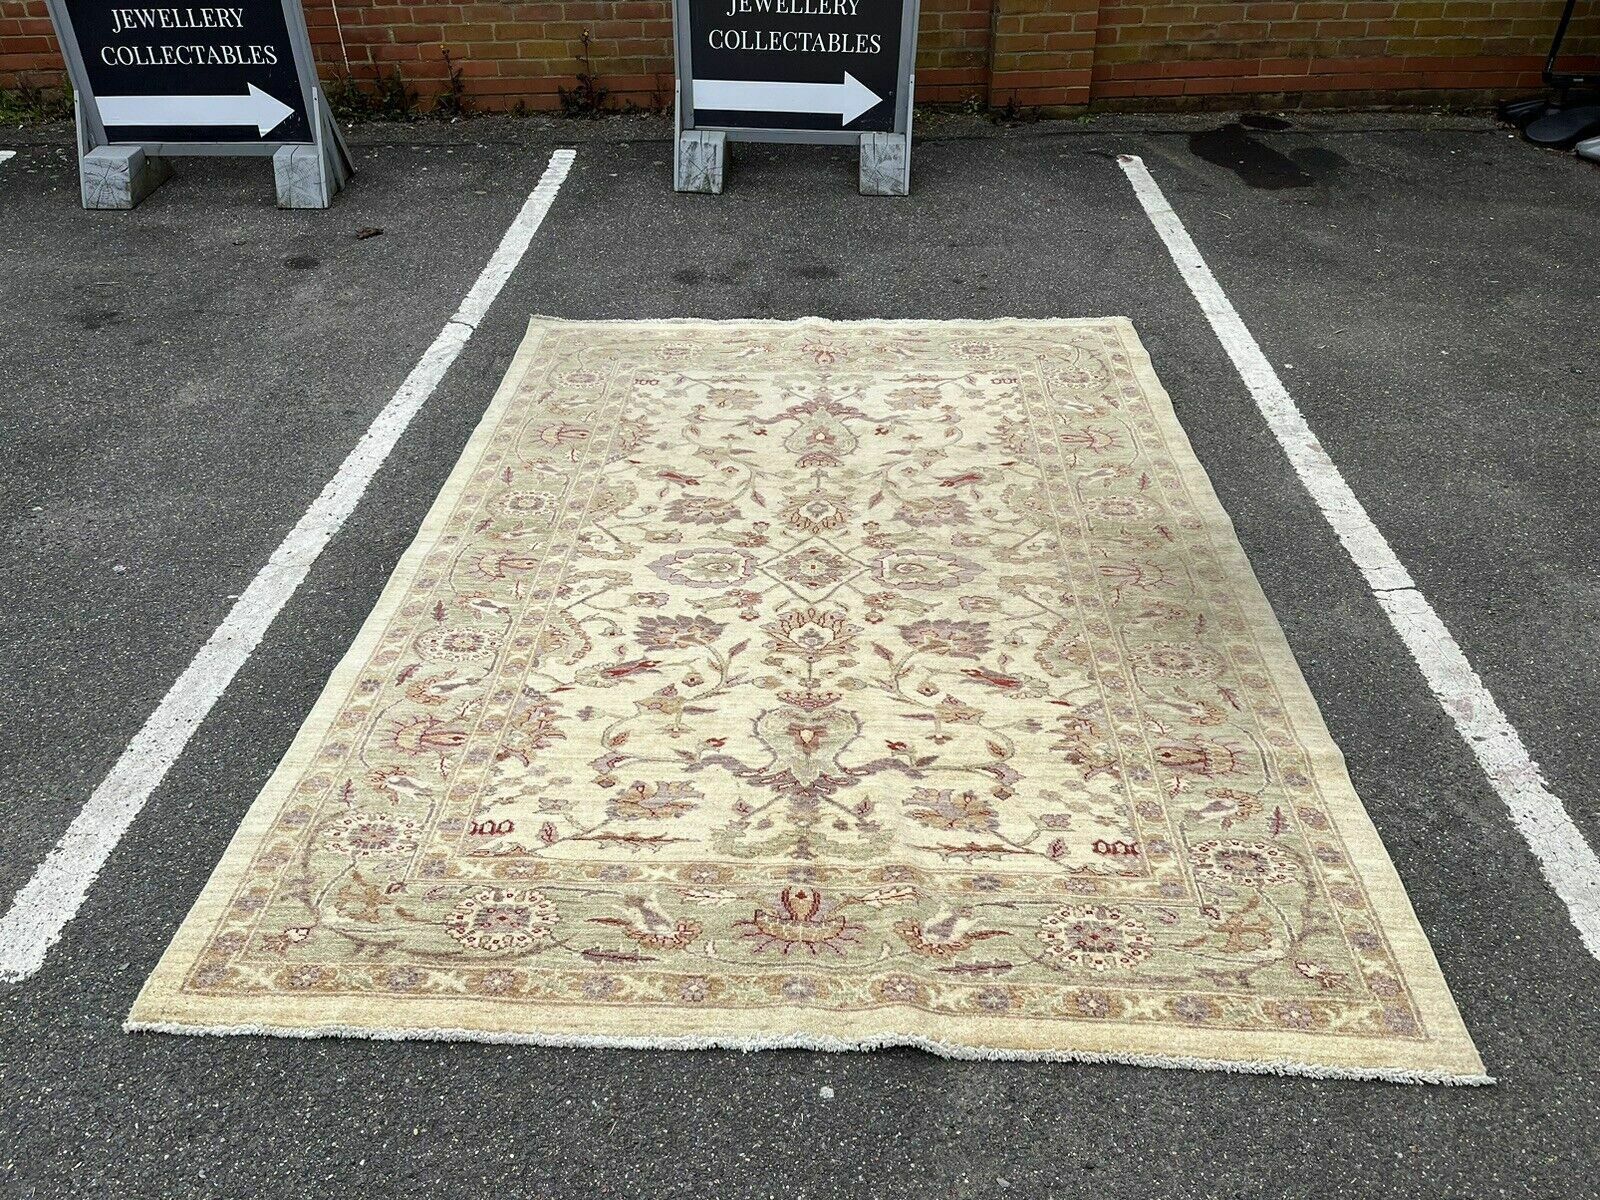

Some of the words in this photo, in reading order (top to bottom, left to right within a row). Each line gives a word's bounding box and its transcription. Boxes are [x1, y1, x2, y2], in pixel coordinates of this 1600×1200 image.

[725, 0, 861, 17] JEWELLERY
[111, 7, 244, 34] JEWELLERY
[708, 29, 881, 54] COLLECTABLES
[100, 45, 278, 66] COLLECTABLES
